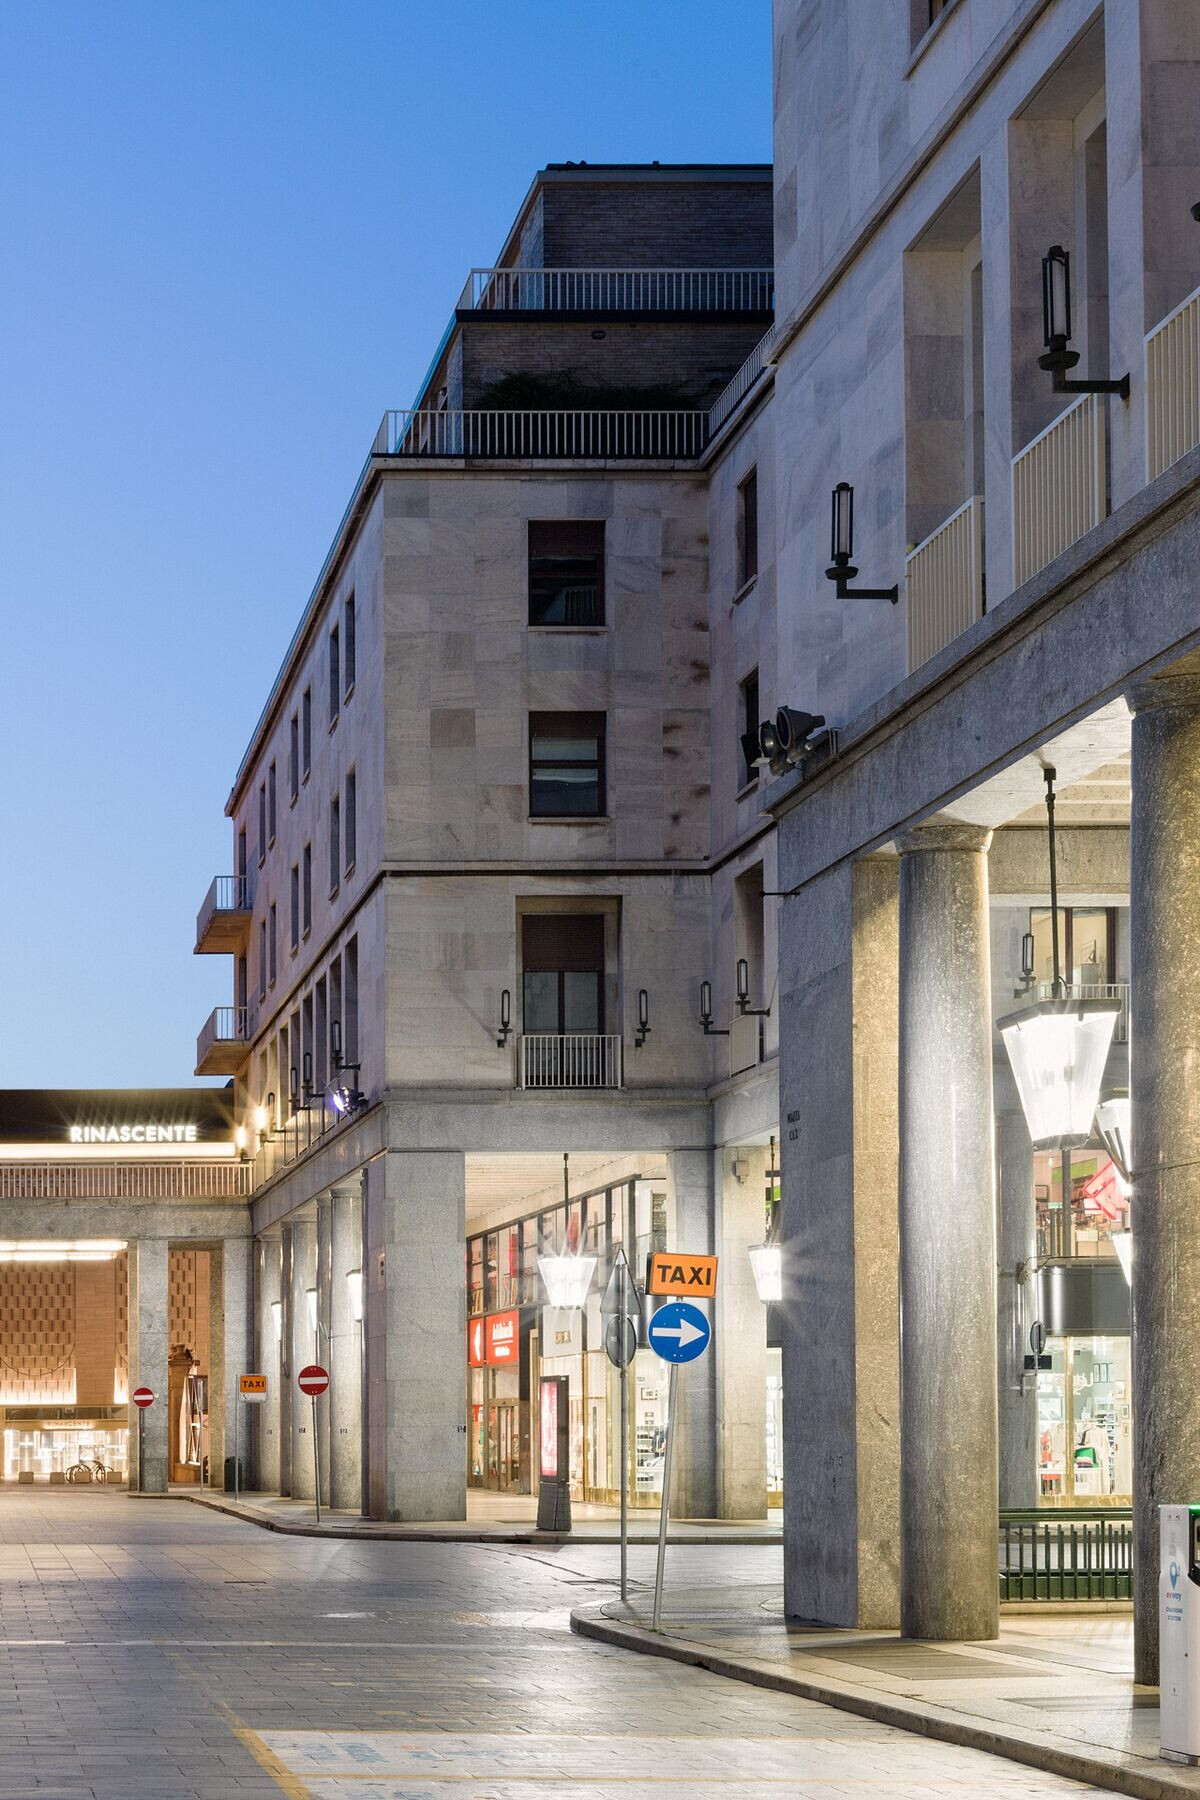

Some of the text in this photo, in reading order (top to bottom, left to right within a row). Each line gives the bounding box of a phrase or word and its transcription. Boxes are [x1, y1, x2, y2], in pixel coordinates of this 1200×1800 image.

[70, 1125, 198, 1142] RINASCENTE
[657, 1265, 712, 1286] TAXI
[242, 1380, 265, 1388] TAXI
